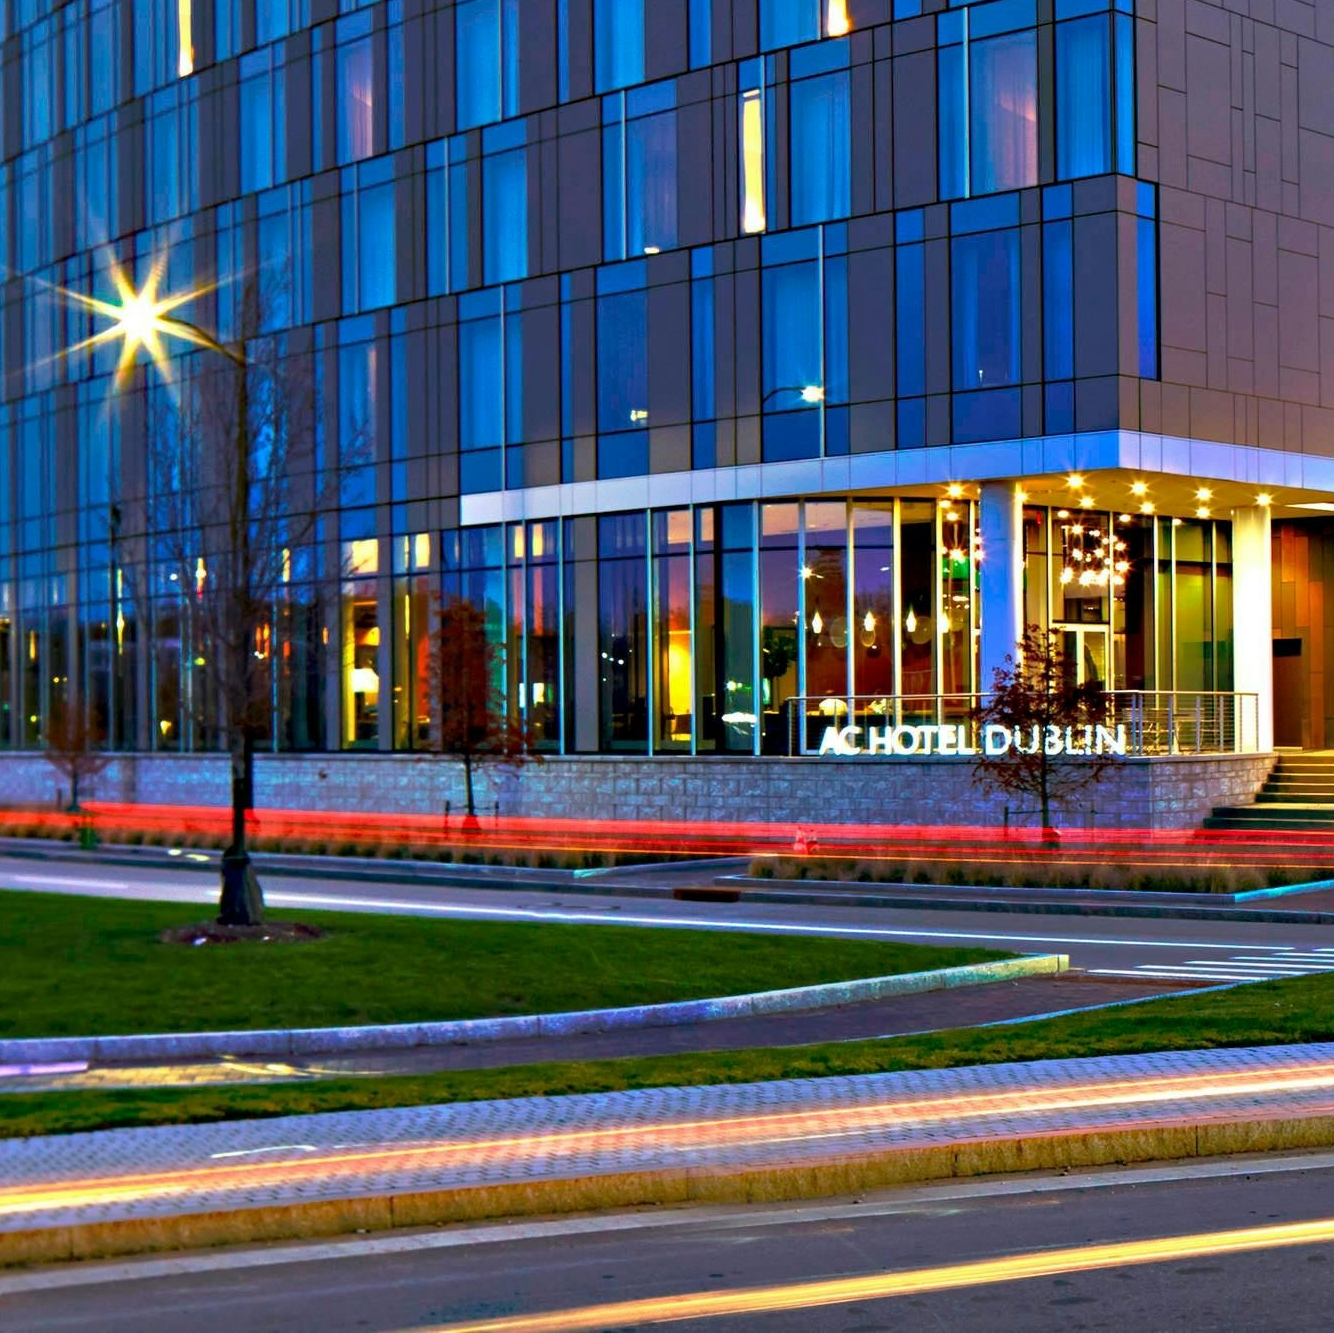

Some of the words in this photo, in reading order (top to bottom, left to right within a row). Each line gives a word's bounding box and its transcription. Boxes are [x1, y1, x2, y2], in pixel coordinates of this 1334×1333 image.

[818, 725, 861, 756] AC
[869, 725, 976, 756] HOTEL
[985, 724, 1126, 756] DUBLIN
